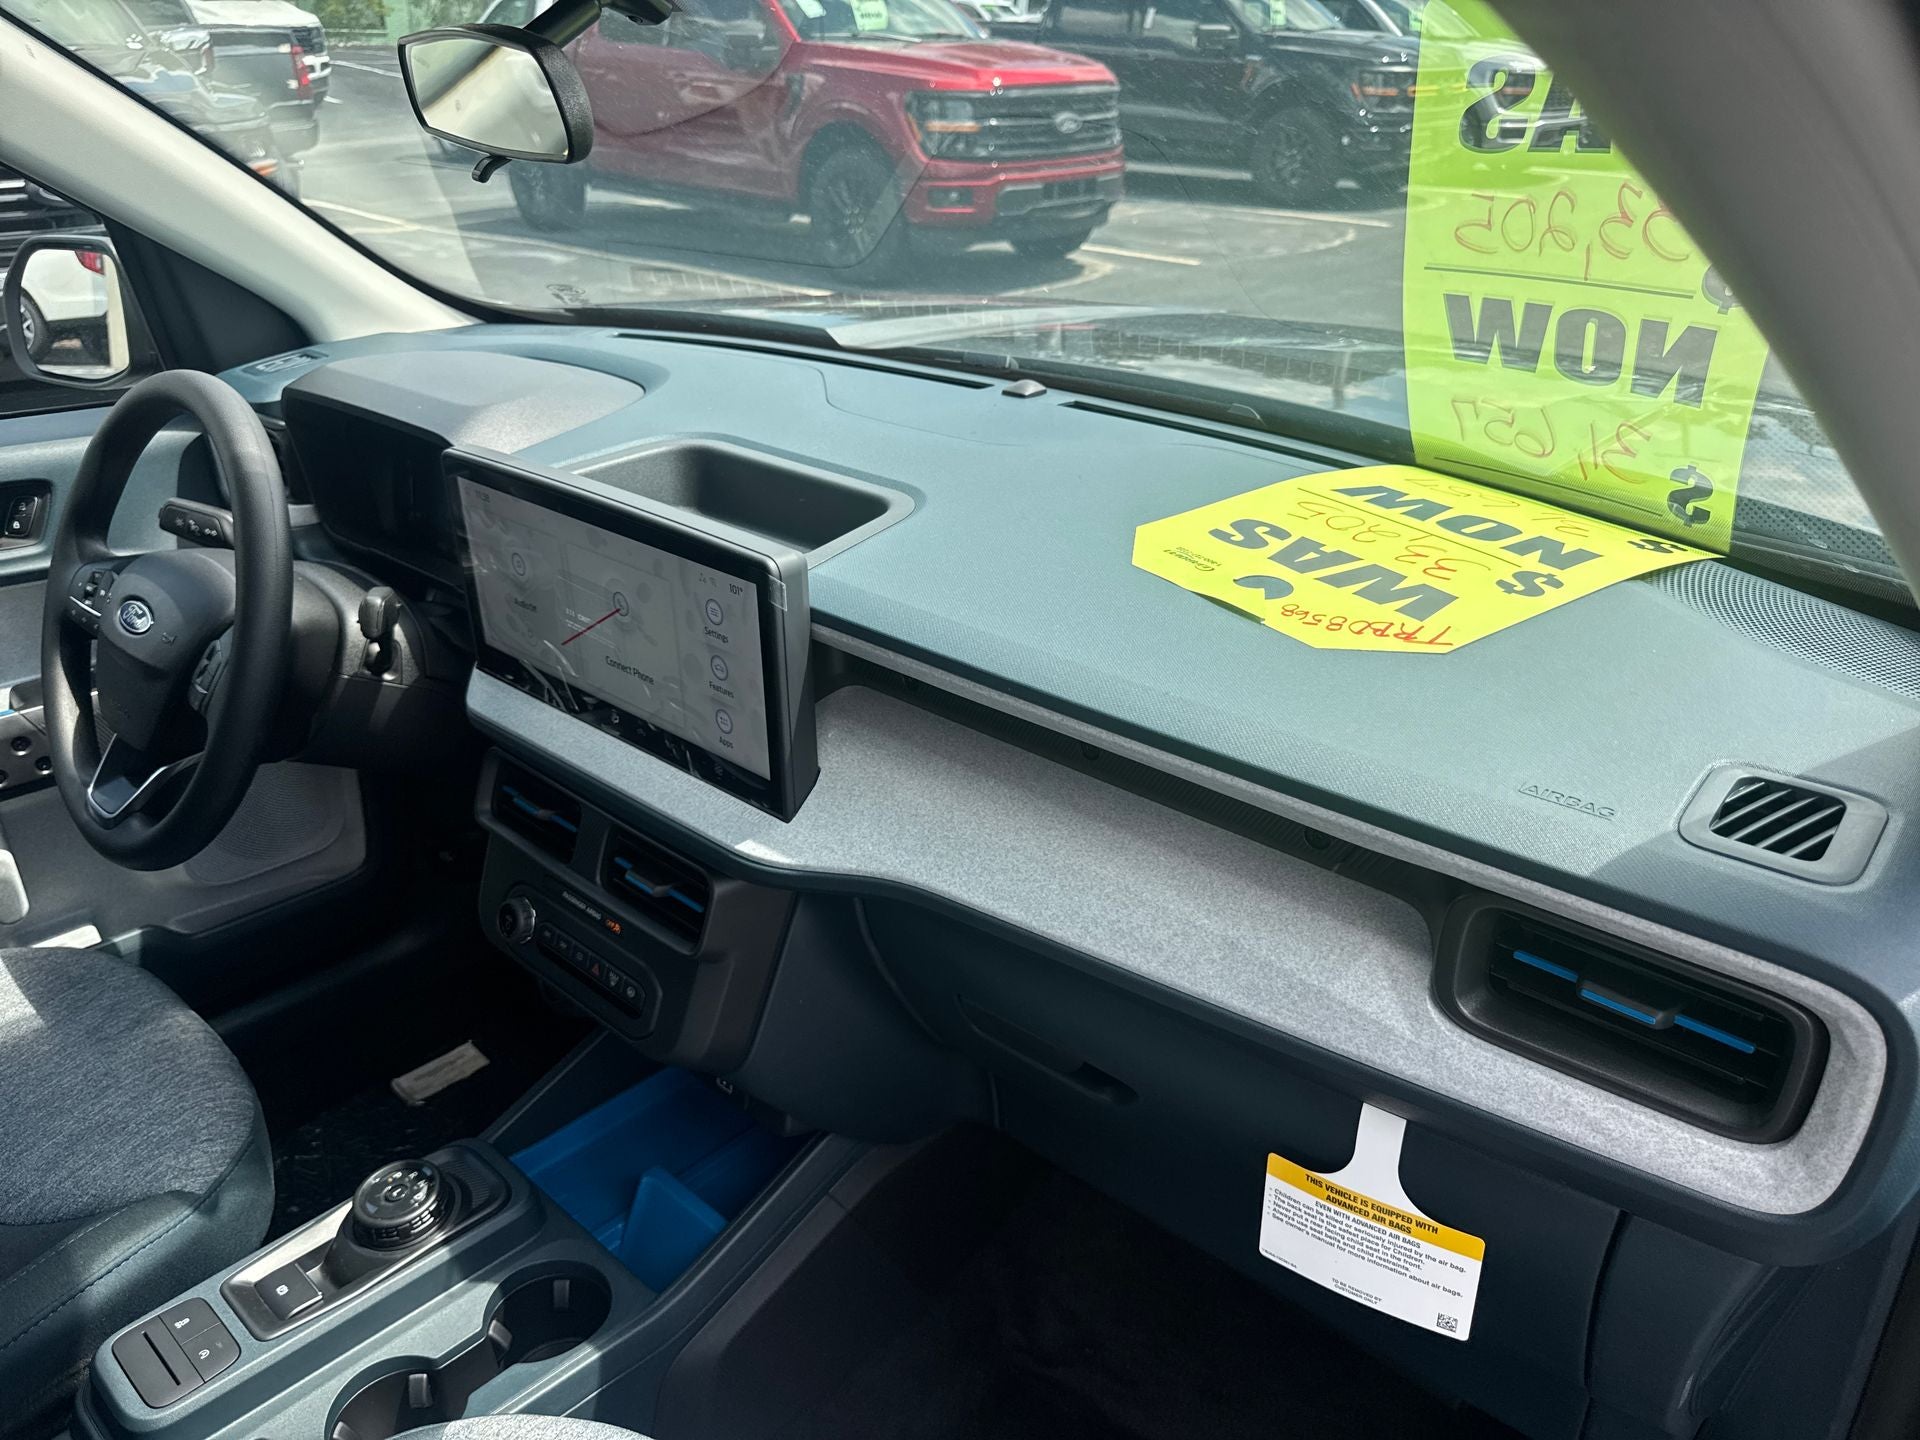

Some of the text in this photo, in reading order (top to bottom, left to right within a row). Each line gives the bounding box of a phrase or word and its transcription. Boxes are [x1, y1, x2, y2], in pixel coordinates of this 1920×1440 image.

[1330, 484, 1605, 571] NOW
[1207, 518, 1460, 623] WAS
[704, 626, 729, 645] Settings
[605, 655, 655, 686] Connect Phone
[709, 680, 735, 699] Features
[719, 736, 734, 750] Apps
[1519, 783, 1616, 818] AIRBAG
[1274, 1194, 1285, 1205] The
[1287, 1201, 1302, 1213] back
[1304, 1210, 1317, 1220] seat
[1326, 1220, 1337, 1229] the
[1338, 1225, 1359, 1238] safest
[1360, 1234, 1380, 1248] place
[1381, 1243, 1391, 1251] for
[1274, 1188, 1301, 1205] Children
[1302, 1203, 1314, 1212] can
[1316, 1208, 1323, 1216] be
[1326, 1213, 1344, 1225] killed
[1354, 1225, 1385, 1244] seriously
[1387, 1239, 1413, 1253] injured
[1414, 1249, 1423, 1258] by
[1425, 1253, 1437, 1262] the
[1438, 1258, 1448, 1267] air
[1305, 1174, 1438, 1234] THIS VEHICLE IS EQUIPPED WITH
[1315, 1201, 1421, 1249] EVEN WITH ADVANCED AIR BAGS
[1326, 1194, 1412, 1234] ADVANCED AIR BAGS
[1273, 1207, 1295, 1222] Always
[1342, 1240, 1356, 1250] and
[1357, 1246, 1374, 1258] child
[1292, 1210, 1303, 1220] put
[1310, 1219, 1323, 1229] rear
[1324, 1225, 1345, 1241] facing
[1347, 1235, 1364, 1247] child
[1365, 1243, 1380, 1254] seat
[1390, 1253, 1401, 1262] the
[1336, 1244, 1346, 1252] for
[1367, 1256, 1407, 1278] information
[1409, 1273, 1430, 1286] about
[1431, 1281, 1440, 1290] air
